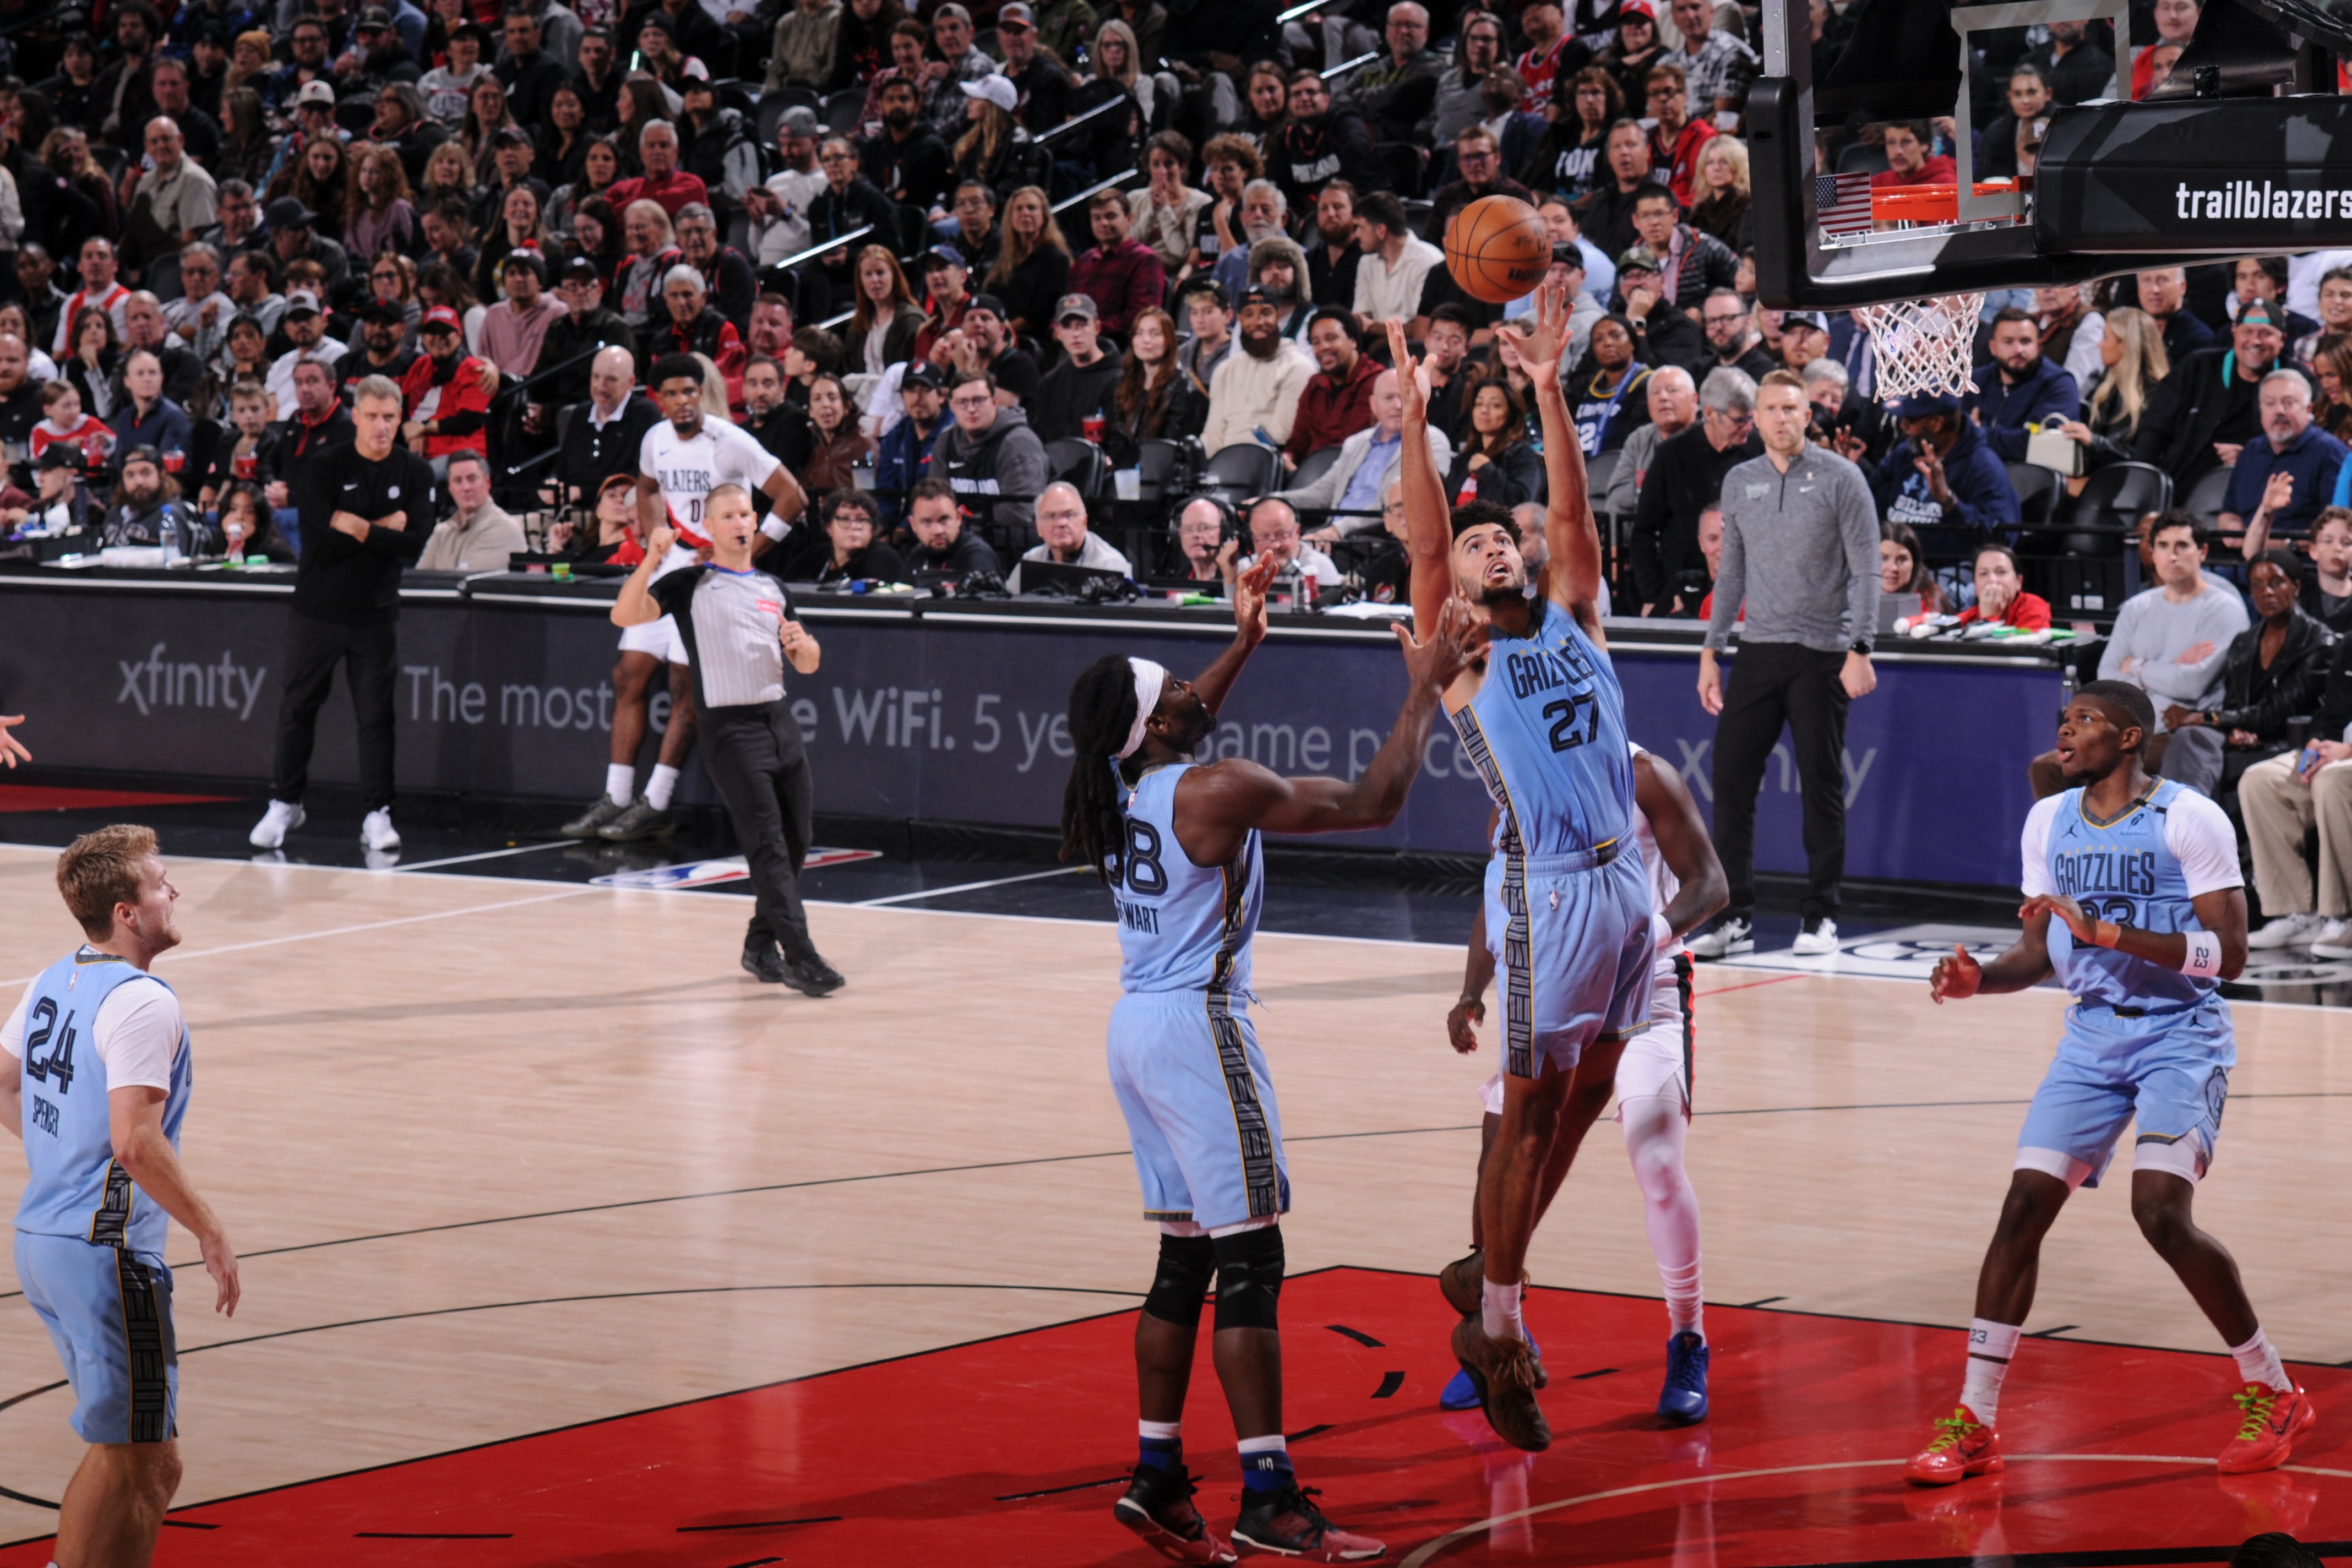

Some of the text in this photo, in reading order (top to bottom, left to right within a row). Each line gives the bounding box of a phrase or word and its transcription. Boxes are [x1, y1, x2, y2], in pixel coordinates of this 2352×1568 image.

[2176, 180, 2352, 219] trailblazers
[658, 470, 712, 493] BLAZERS
[117, 642, 266, 721] xfinity
[404, 665, 486, 725] The
[500, 680, 615, 731] most
[832, 686, 956, 750] WiFi.
[973, 694, 1001, 753] 5
[1542, 687, 1599, 754] 27
[2055, 851, 2154, 896] GRIZZLIES
[2193, 946, 2209, 968] 23
[26, 996, 77, 1095] 24
[32, 1093, 59, 1139] SPENCER
